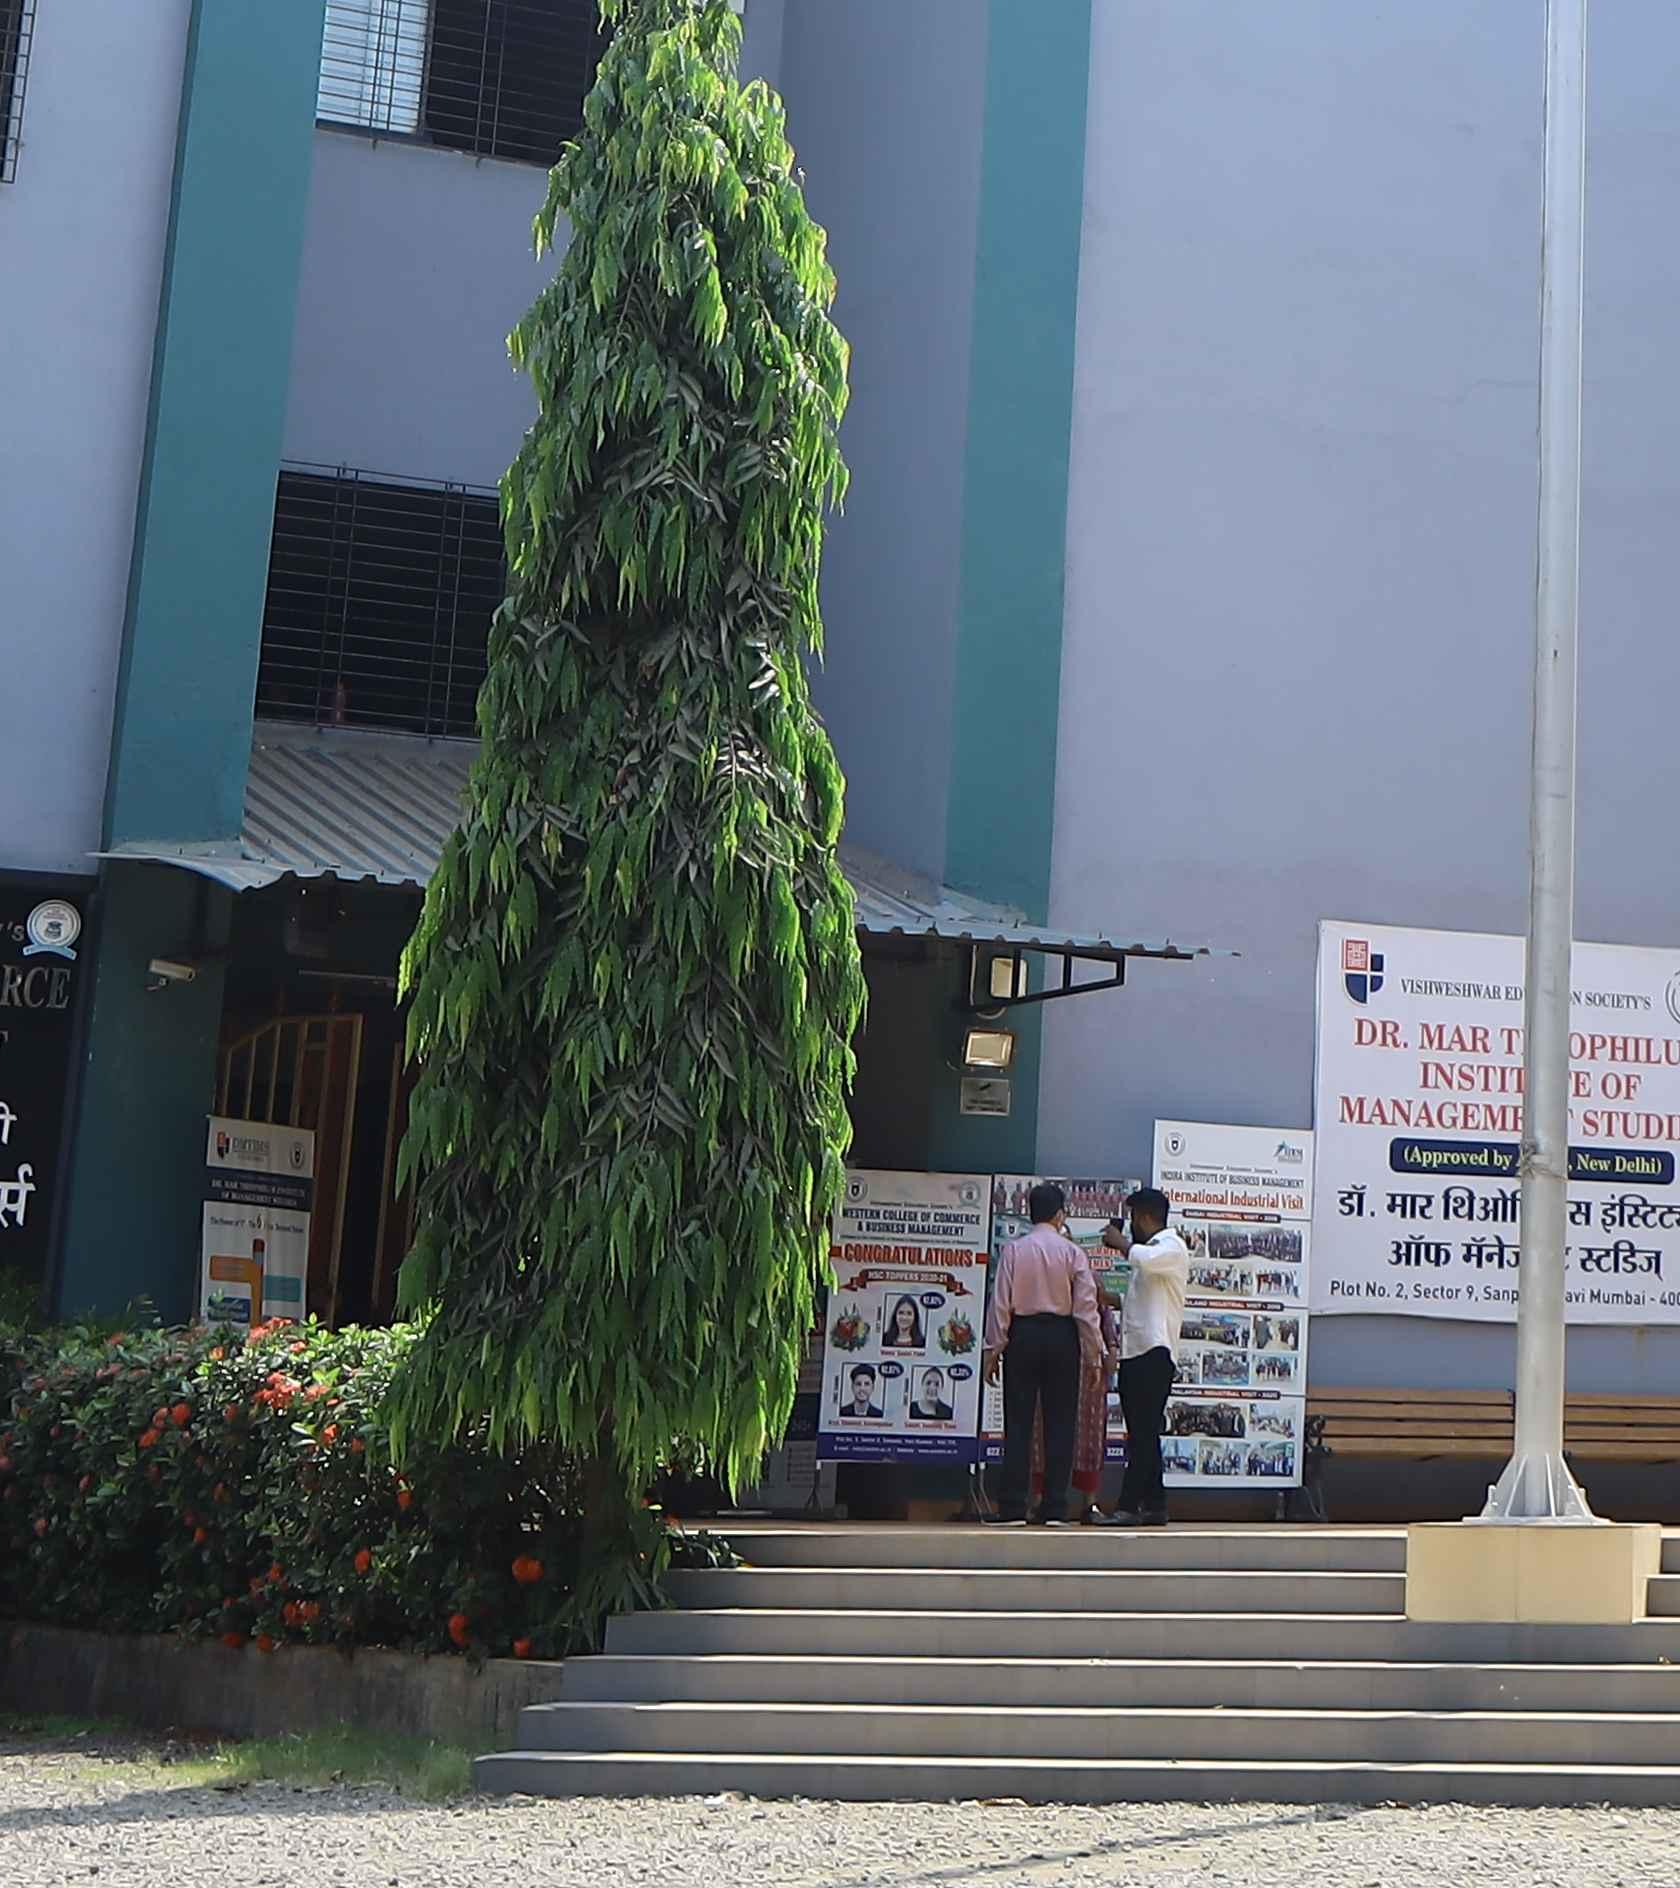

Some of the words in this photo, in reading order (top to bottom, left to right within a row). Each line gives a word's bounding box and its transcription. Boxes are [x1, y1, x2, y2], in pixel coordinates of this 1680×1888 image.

[1400, 978, 1502, 1000] VISHWESHWAR
[1354, 1017, 1410, 1049] DR.
[1418, 1022, 1492, 1054] MAR
[1419, 1061, 1592, 1098] INSTITE
[1600, 1072, 1643, 1100] OF
[1404, 1145, 1489, 1169] (Approved
[1493, 1149, 1512, 1170] by
[1576, 1153, 1611, 1172] New
[1614, 1155, 1663, 1176] Delhi)
[1229, 1175, 1260, 1186] BUSINESS
[1262, 1177, 1305, 1189] MANAGEMENT
[1230, 1190, 1280, 1208] Industrial
[1282, 1194, 1304, 1210] Visit
[1386, 1192, 1435, 1219] मार
[865, 1222, 905, 1234] BUSINESS
[908, 1224, 965, 1237] MANAGEMENT
[882, 1210, 918, 1223] COLLEGE
[920, 1211, 931, 1223] OF
[933, 1212, 981, 1225] COMMERCE
[844, 1243, 973, 1267] CONGRATULATIONS
[1387, 1234, 1452, 1267] ऑफ
[1330, 1280, 1361, 1296] Plot
[1365, 1281, 1391, 1298] No.
[1395, 1282, 1409, 1300] 2,
[1413, 1283, 1462, 1300] Sector
[1466, 1284, 1479, 1302] 9,
[1589, 1288, 1646, 1306] Mumbai
